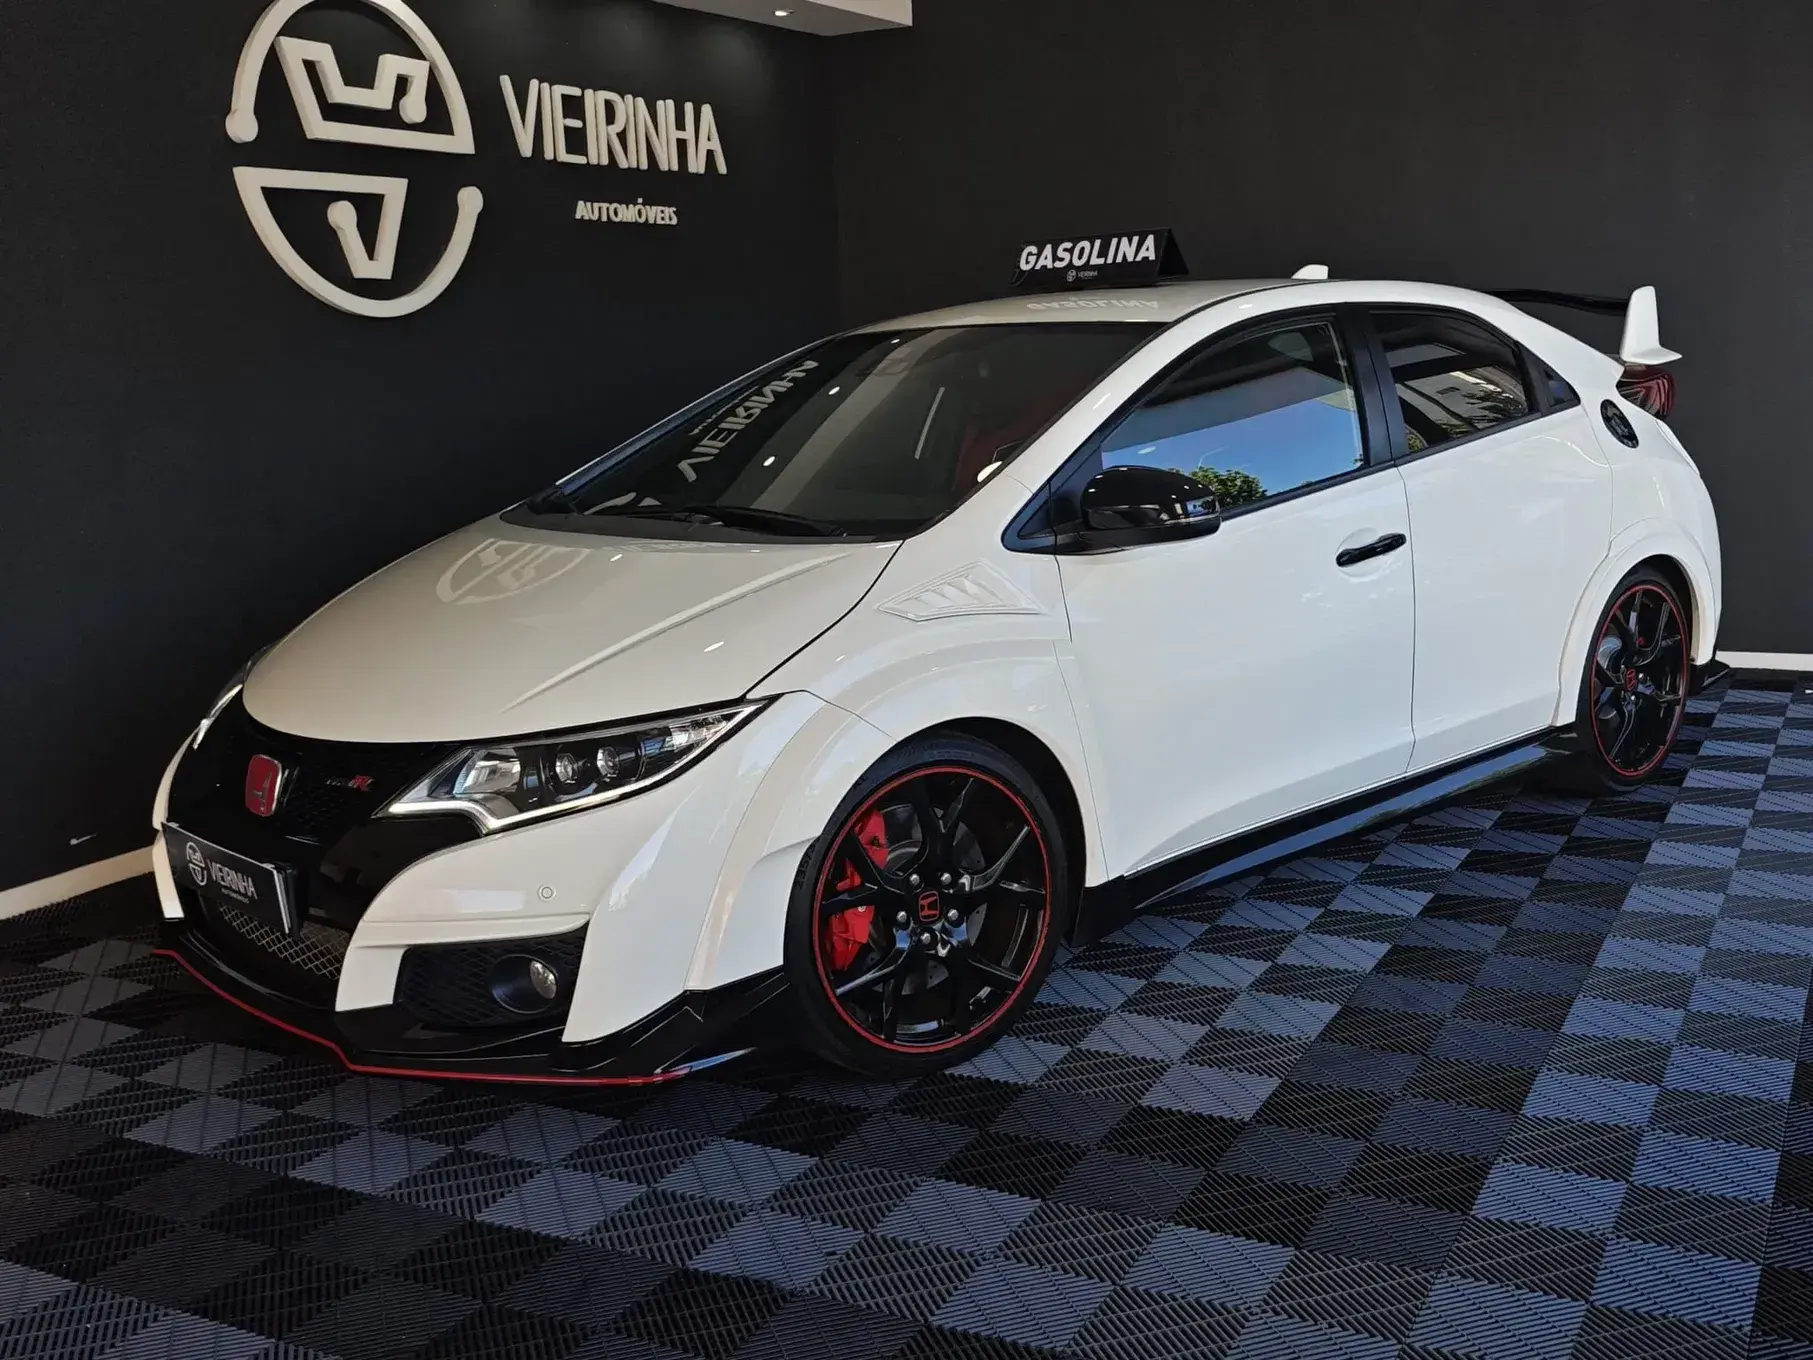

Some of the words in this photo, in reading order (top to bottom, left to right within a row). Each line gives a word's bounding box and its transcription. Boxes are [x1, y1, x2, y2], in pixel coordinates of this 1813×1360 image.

[499, 74, 728, 175] VIEIRINHA
[575, 197, 678, 226] AUTOMÓVEIS
[1019, 234, 1156, 271] GASOLINA
